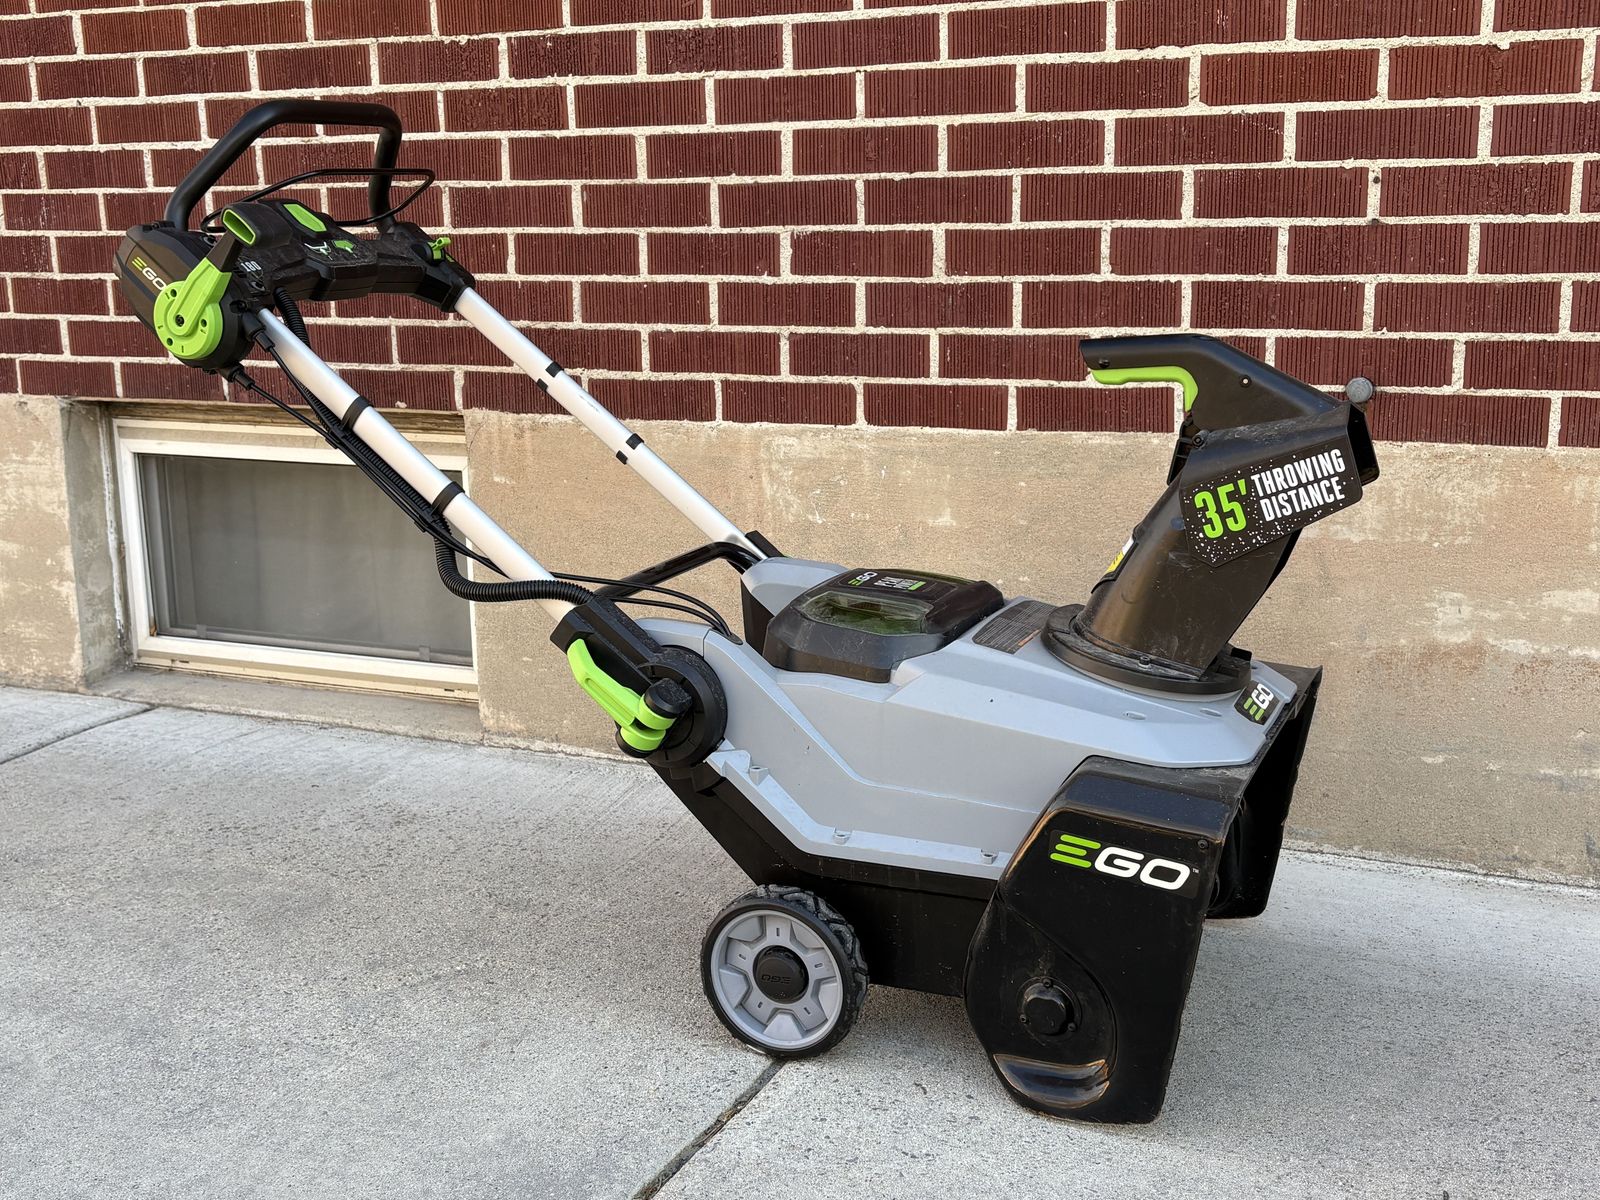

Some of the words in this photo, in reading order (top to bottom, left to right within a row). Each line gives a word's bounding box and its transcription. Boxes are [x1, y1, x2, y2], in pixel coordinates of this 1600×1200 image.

[131, 256, 167, 290] EGO
[1250, 448, 1346, 496] THROWING
[1193, 478, 1247, 539] 35'
[1259, 476, 1345, 522] DISTANCE
[847, 571, 878, 586] EGO
[1243, 683, 1274, 721] EGO
[1049, 834, 1191, 891] EGO
